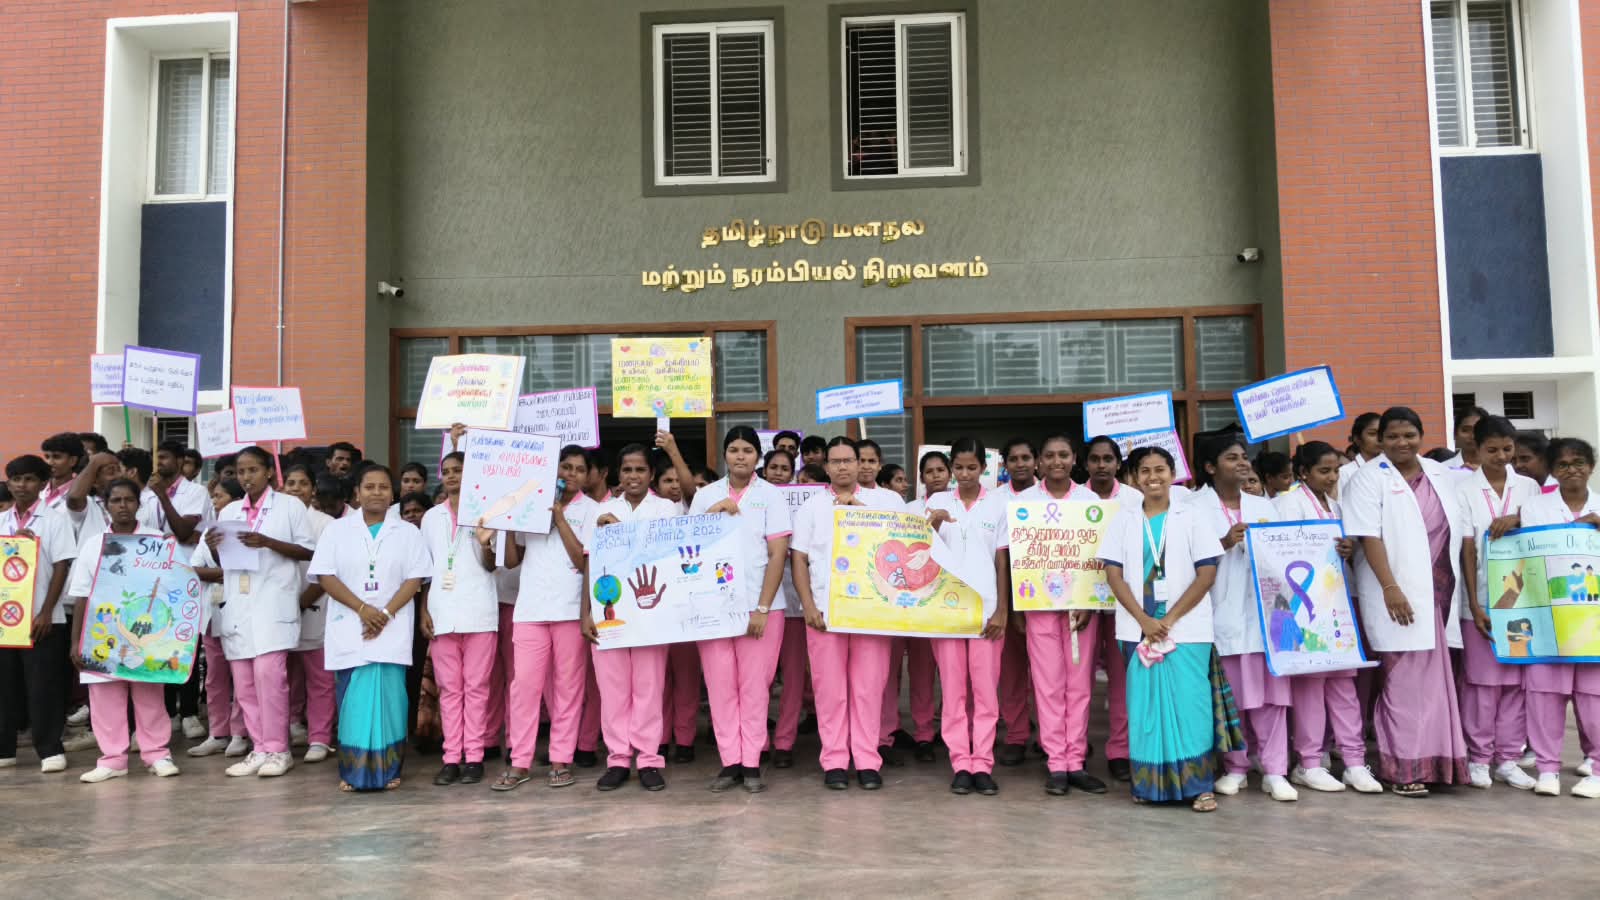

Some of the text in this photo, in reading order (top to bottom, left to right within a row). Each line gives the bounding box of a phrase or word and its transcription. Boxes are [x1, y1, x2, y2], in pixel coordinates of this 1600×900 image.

[700, 218, 925, 248] தமிழ்நாடு மனநல
[641, 256, 989, 292] மற்றும் நரம்பியல் நிறுவனம்
[1011, 526, 1098, 544] தற்கொலை ஒரு
[136, 537, 164, 556] SAY
[1051, 541, 1080, 557] அல்ல
[134, 557, 174, 570] SUICIDE
